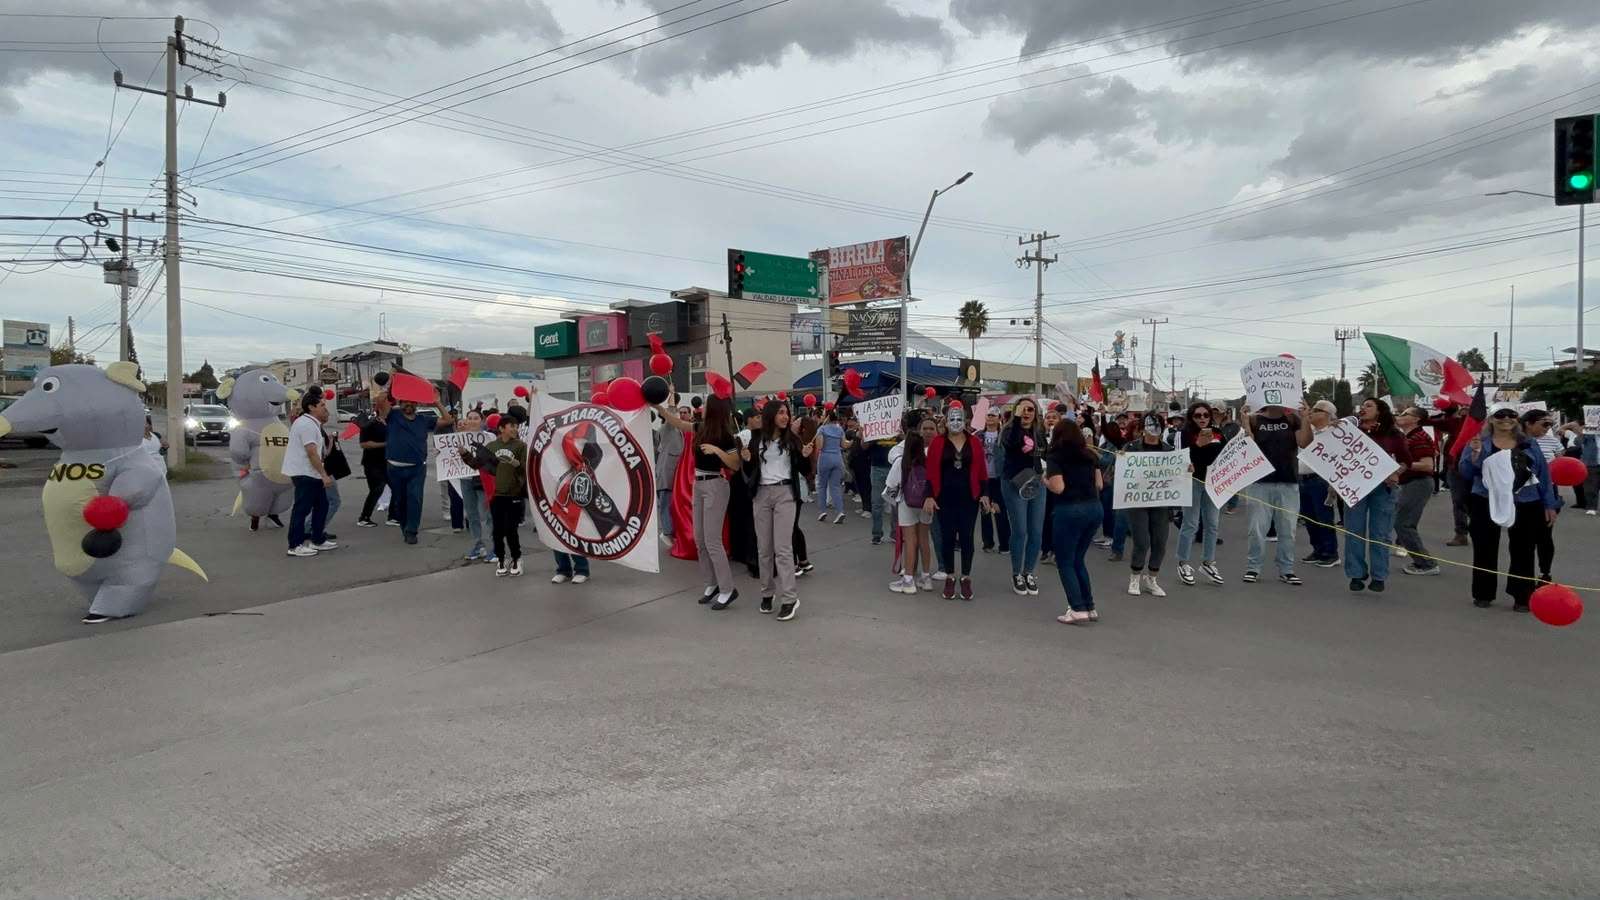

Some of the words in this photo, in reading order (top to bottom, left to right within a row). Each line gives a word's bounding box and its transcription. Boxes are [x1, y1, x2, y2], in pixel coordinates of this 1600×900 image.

[829, 240, 885, 269] BIRRIA
[1259, 361, 1295, 370] INSUMOS
[1261, 382, 1295, 390] ALCANZA
[863, 402, 871, 413] LA
[873, 396, 899, 411] SALUD
[869, 412, 876, 420] ES
[881, 411, 891, 419] UN
[1259, 422, 1288, 431] AERO
[439, 432, 485, 449] SEGURO
[561, 408, 641, 469] TRABAJADORA
[1331, 421, 1379, 466] Salario
[1127, 454, 1183, 467] QUEREMOS
[1311, 442, 1350, 476] Retiro
[1341, 448, 1373, 480] Digno
[1123, 469, 1135, 478] EL
[1143, 467, 1181, 479] SALARIO
[1123, 490, 1180, 503] ROBLEDO
[539, 500, 579, 548] UNIDAD
[582, 541, 589, 553] Y
[592, 515, 641, 556] DIGNIDAD
